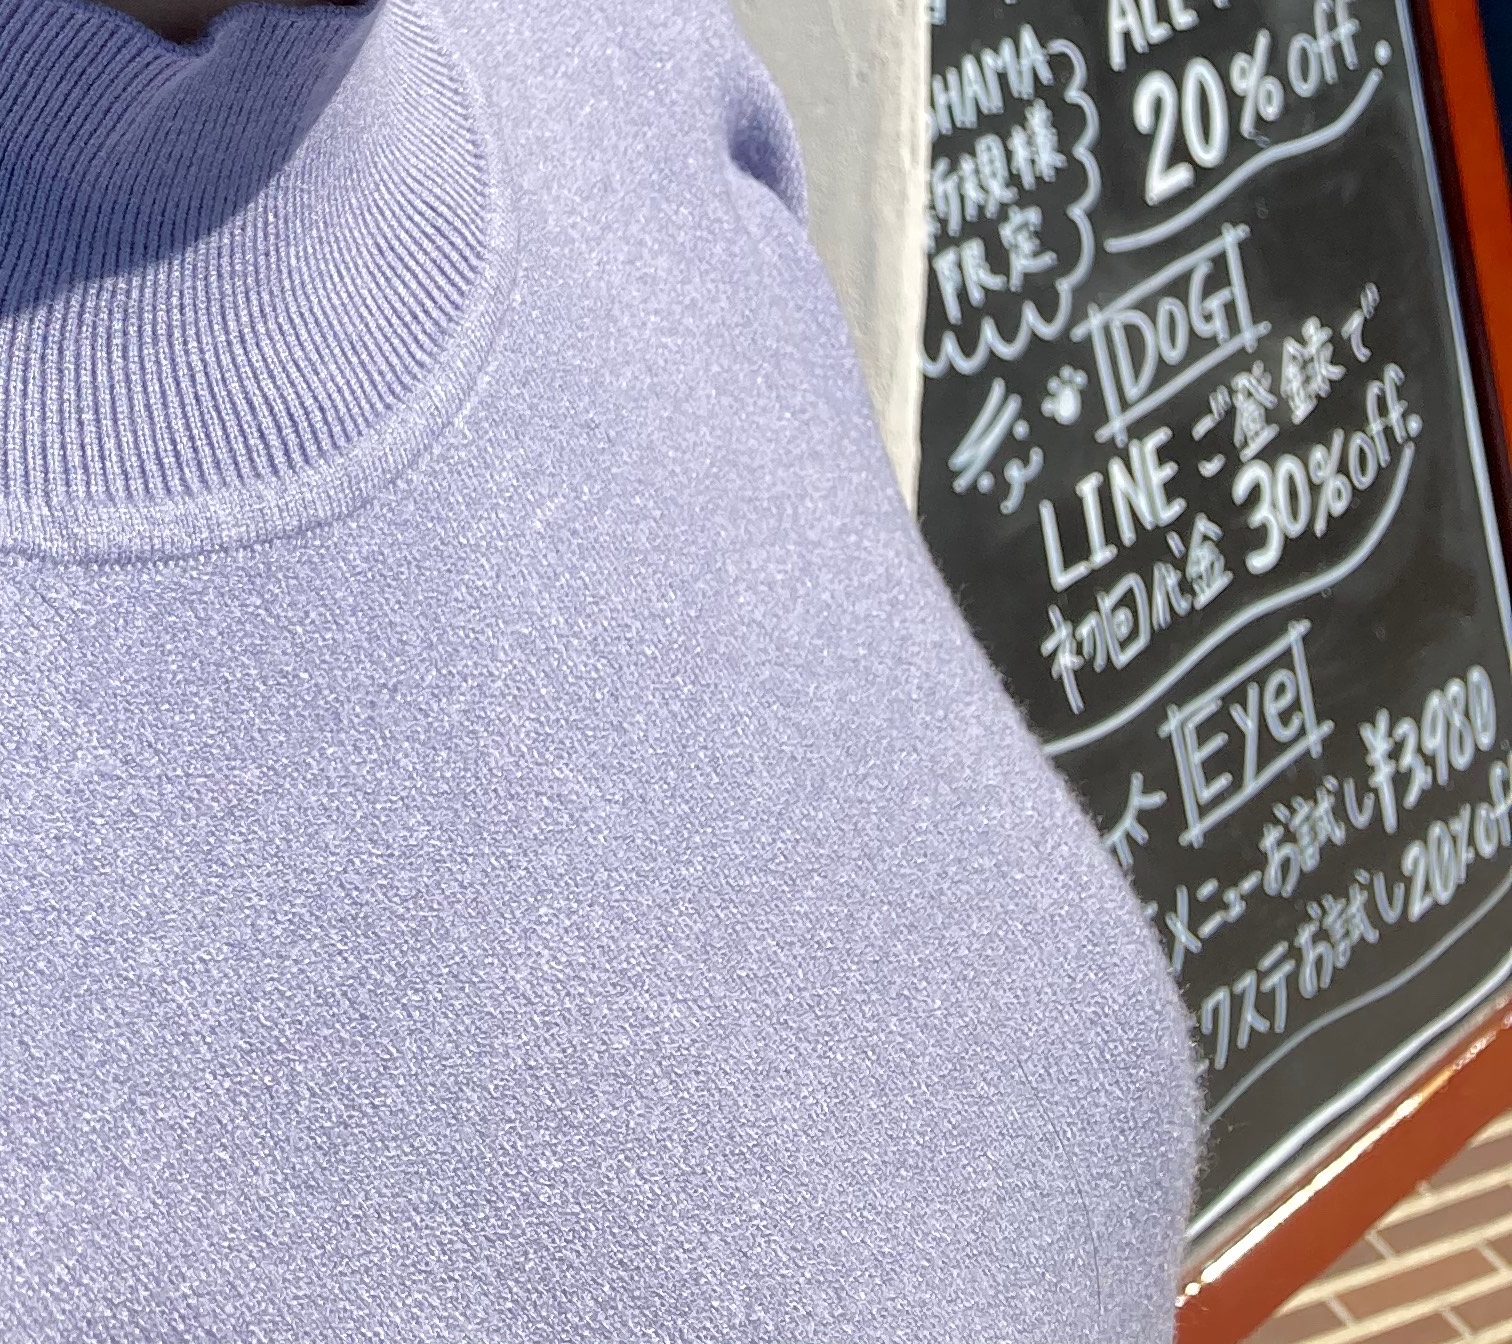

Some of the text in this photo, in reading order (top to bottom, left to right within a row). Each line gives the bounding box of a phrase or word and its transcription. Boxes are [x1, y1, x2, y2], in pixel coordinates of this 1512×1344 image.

[920, 23, 1056, 144] HAMA
[1107, 258, 1238, 406] DOG
[1038, 424, 1188, 594] LINE
[1186, 667, 1305, 806] Eye
